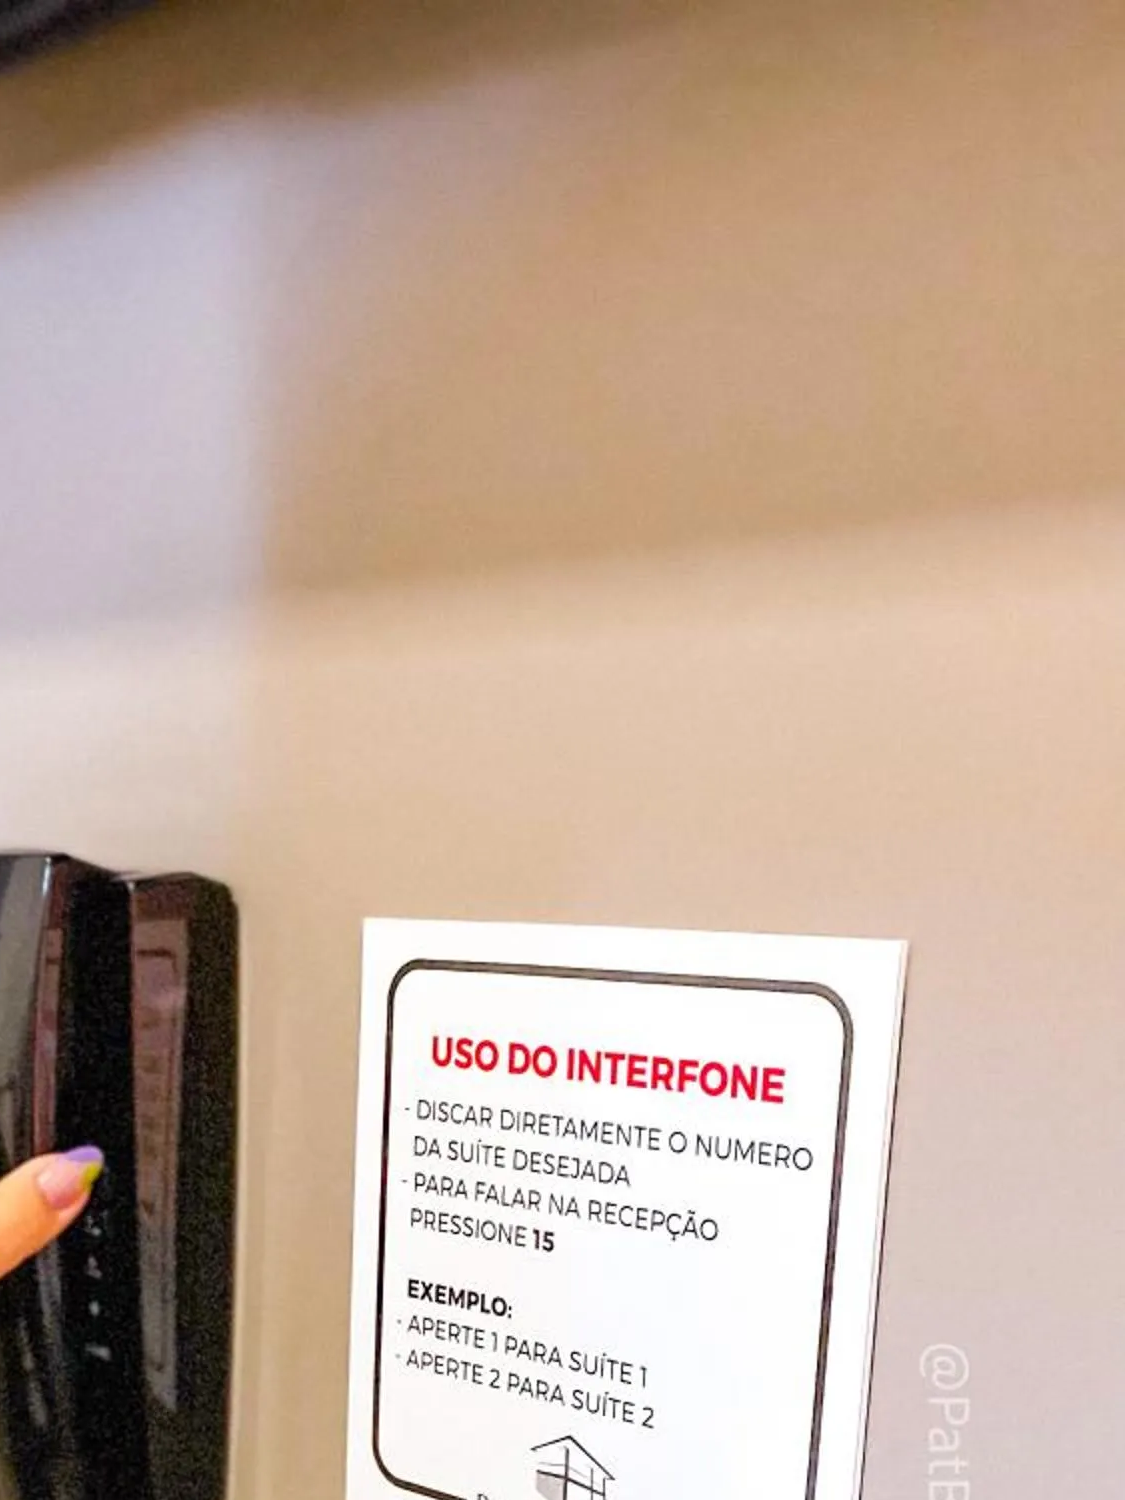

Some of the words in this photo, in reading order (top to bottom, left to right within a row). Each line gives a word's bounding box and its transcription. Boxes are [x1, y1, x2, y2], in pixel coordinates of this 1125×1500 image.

[431, 1036, 499, 1072] USO
[508, 1043, 557, 1079] DO
[566, 1048, 786, 1104] INTERFONE
[413, 1135, 442, 1159] DA
[447, 1138, 506, 1168] SUÍTE
[513, 1149, 631, 1188] DESEJADA
[416, 1099, 493, 1128] DISCAR
[500, 1109, 660, 1152] DIRETAMENTE
[668, 1131, 688, 1156] O
[695, 1134, 813, 1172] NUMERO
[410, 1207, 527, 1247] PRESSIONE
[532, 1228, 555, 1252] 15
[413, 1172, 468, 1200] PARA
[475, 1181, 542, 1211] FALAR
[549, 1193, 581, 1219] NA
[588, 1200, 719, 1242] RECEPÇÃO
[407, 1278, 513, 1319] EXEMPLO:
[407, 1315, 485, 1349] APERTE
[490, 1331, 498, 1352] 1
[505, 1335, 563, 1368] PARA
[568, 1351, 633, 1385] SUÍTE
[640, 1366, 648, 1388] 1
[406, 1350, 484, 1385] APERTE
[489, 1368, 501, 1389] 2
[507, 1372, 565, 1406] PARA
[571, 1389, 636, 1424] SUÍTE
[641, 1406, 655, 1429] 2
